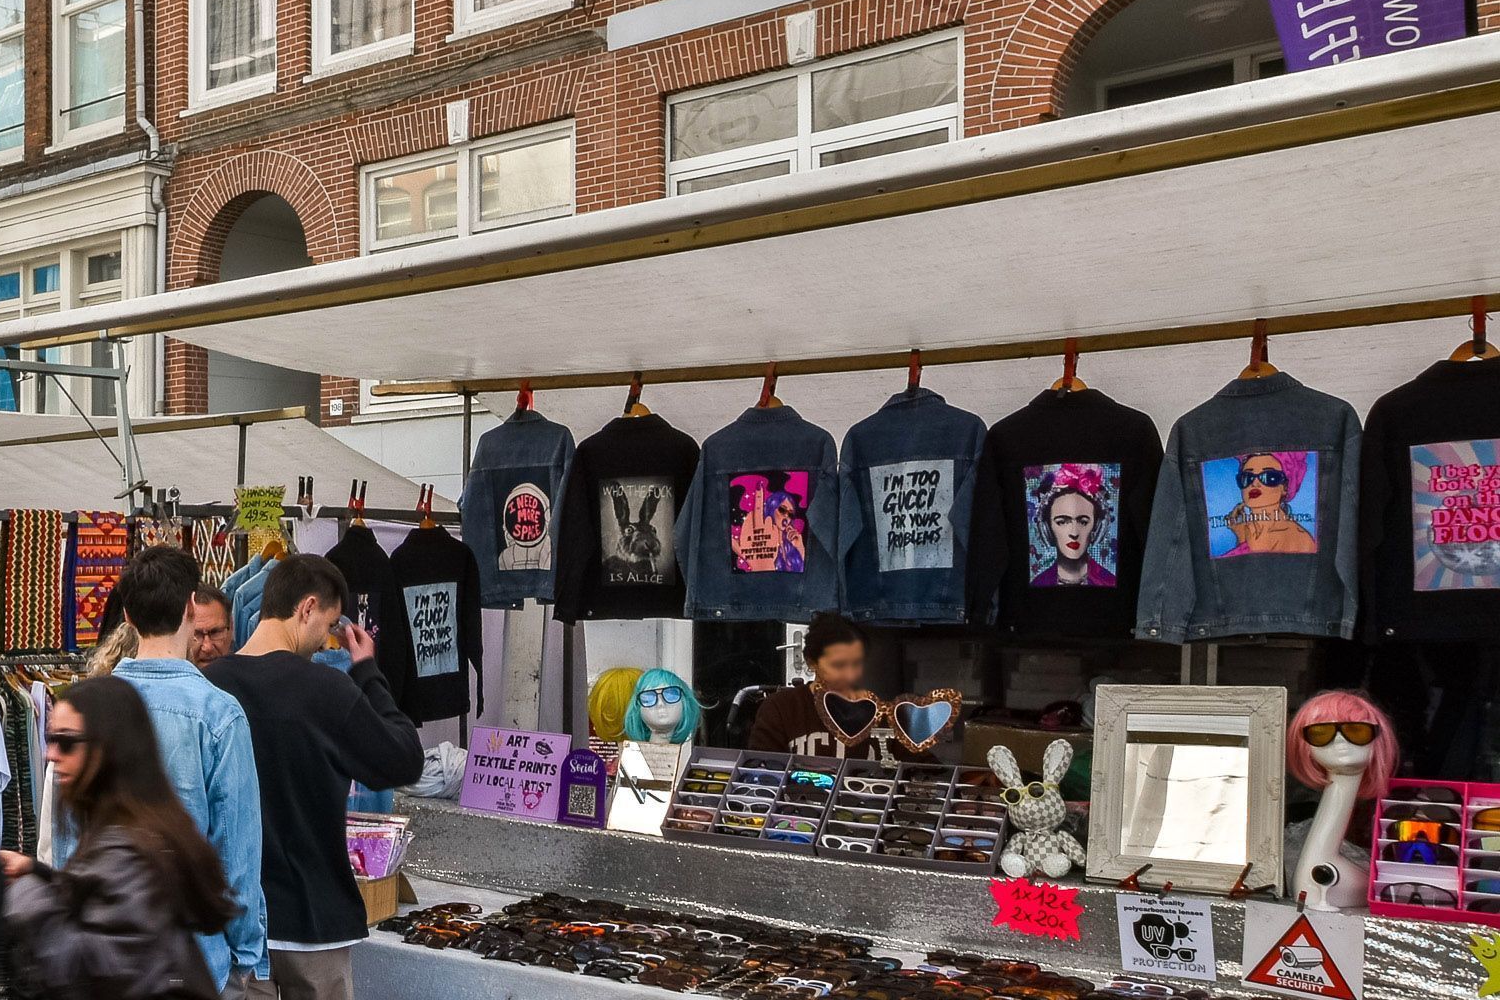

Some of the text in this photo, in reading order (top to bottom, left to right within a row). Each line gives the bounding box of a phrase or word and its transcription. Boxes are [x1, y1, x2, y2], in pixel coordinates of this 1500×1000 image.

[906, 470, 940, 488] TOO
[1430, 465, 1442, 479] I
[1445, 464, 1481, 478] bet
[602, 484, 624, 497] WHO
[627, 484, 648, 496] THE
[1428, 476, 1475, 492] look
[508, 496, 538, 514] I NEED
[882, 488, 936, 515] GUCCI
[1442, 495, 1472, 508] on
[516, 508, 541, 524] MORE
[909, 511, 942, 528] YOUR
[512, 524, 541, 540] SPACE
[609, 572, 664, 584] IS ALICE
[432, 591, 450, 607] TOO
[413, 605, 449, 629] GUCCI
[419, 628, 435, 642] FOR
[506, 734, 531, 749] ART
[512, 749, 519, 758] &
[473, 755, 558, 776] TEXTILE PRINTS
[569, 758, 599, 775] Social
[472, 773, 552, 794] BY LOCAL ARTIST
[1123, 905, 1177, 915] polycarbonate
[1159, 899, 1185, 908] quality
[1141, 924, 1165, 942] UV
[1132, 957, 1206, 974] PROTECTION
[1276, 968, 1325, 985] CAMERA
[1276, 977, 1324, 993] SECURITY
